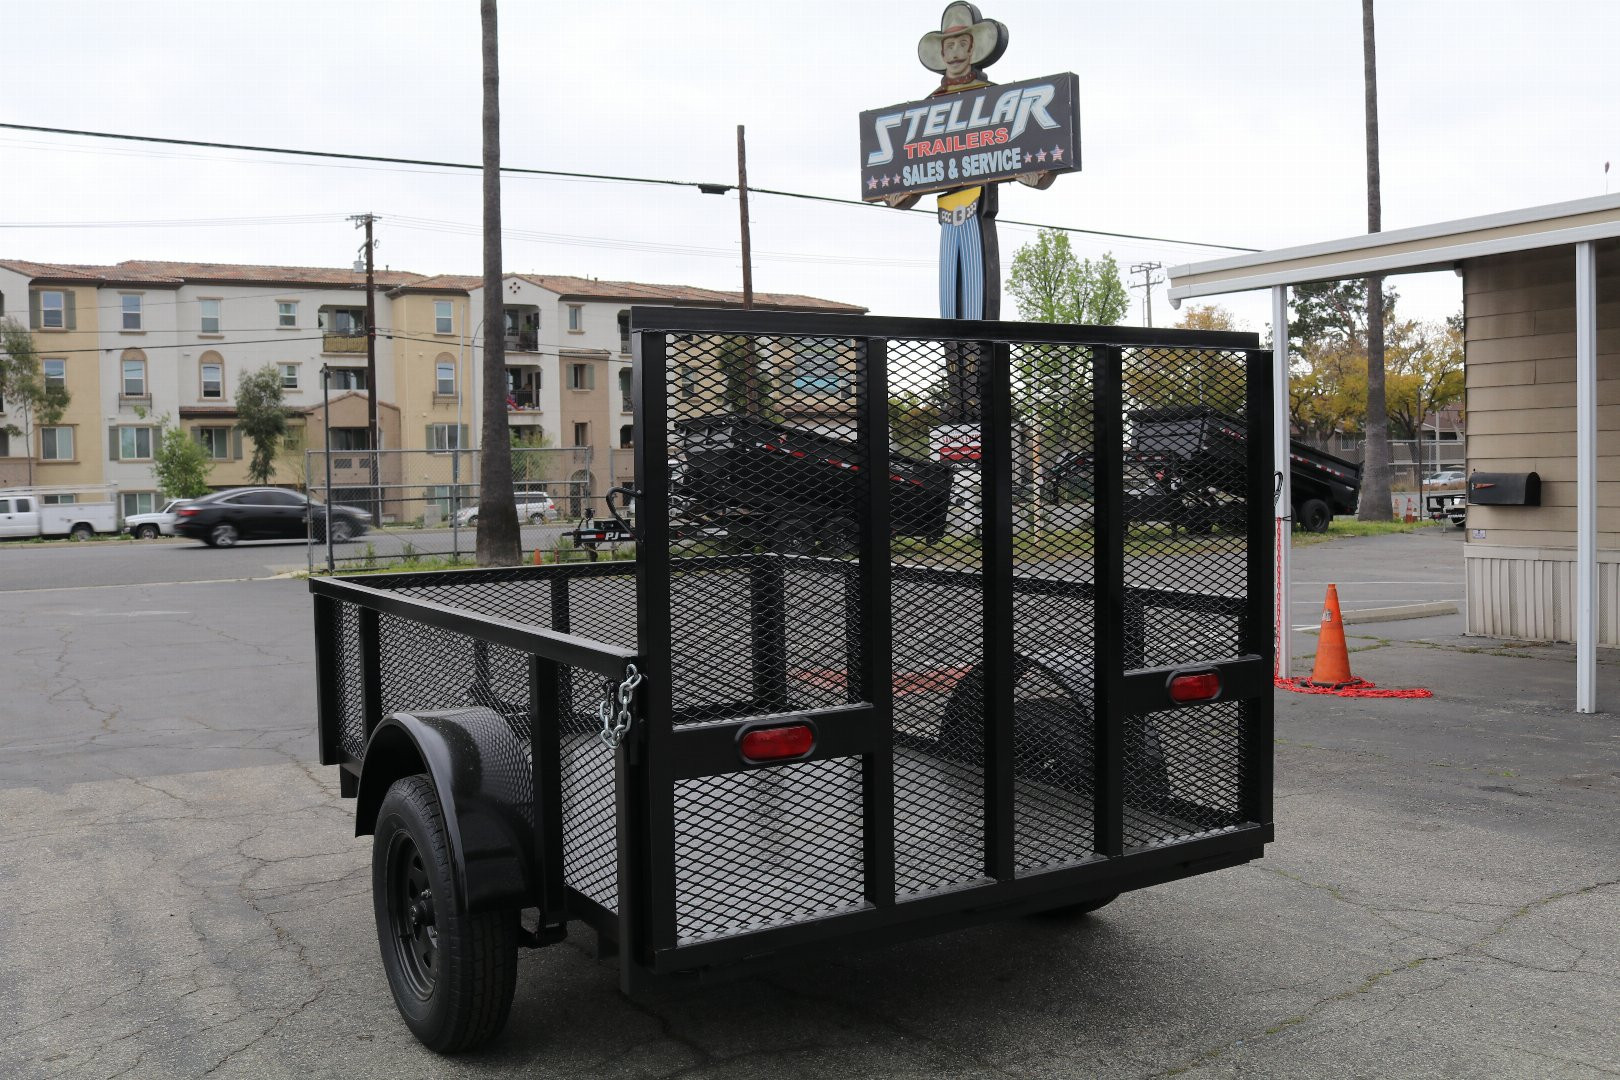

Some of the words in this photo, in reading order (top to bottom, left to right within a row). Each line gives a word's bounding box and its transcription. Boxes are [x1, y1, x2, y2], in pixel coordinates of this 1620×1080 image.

[866, 84, 1061, 168] STELLAR
[903, 127, 1009, 160] TRAILERS
[903, 160, 944, 186] SALES
[948, 158, 959, 179] &
[961, 147, 1022, 177] SERVICE
[605, 532, 619, 540] PJ
